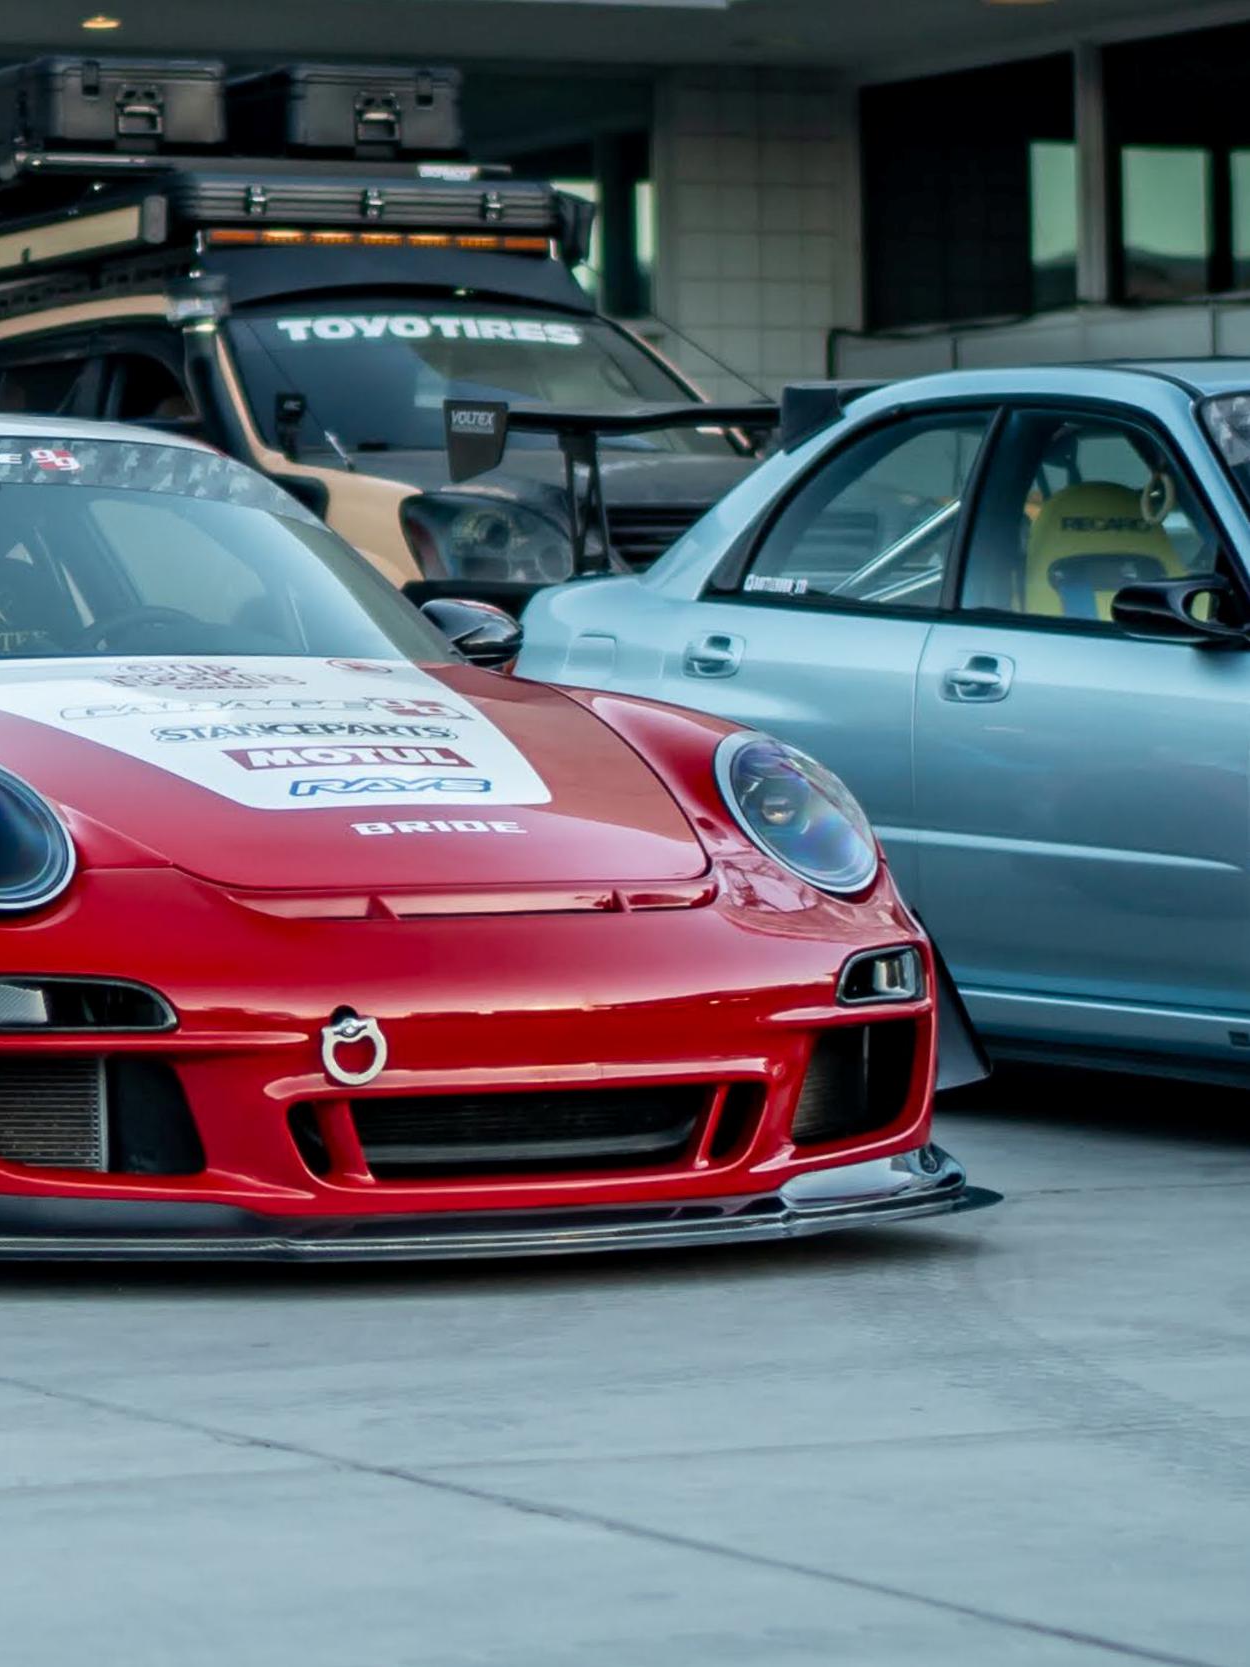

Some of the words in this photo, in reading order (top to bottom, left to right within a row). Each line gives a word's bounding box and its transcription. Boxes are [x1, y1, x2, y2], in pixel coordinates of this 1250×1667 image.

[277, 315, 430, 341] TOYO
[430, 316, 582, 345] TIRES
[30, 449, 80, 471] 99
[153, 724, 459, 743] STANCEPARTS
[247, 748, 461, 768] MOTUL
[290, 778, 492, 797] RAYS
[350, 820, 528, 836] BRIDE
